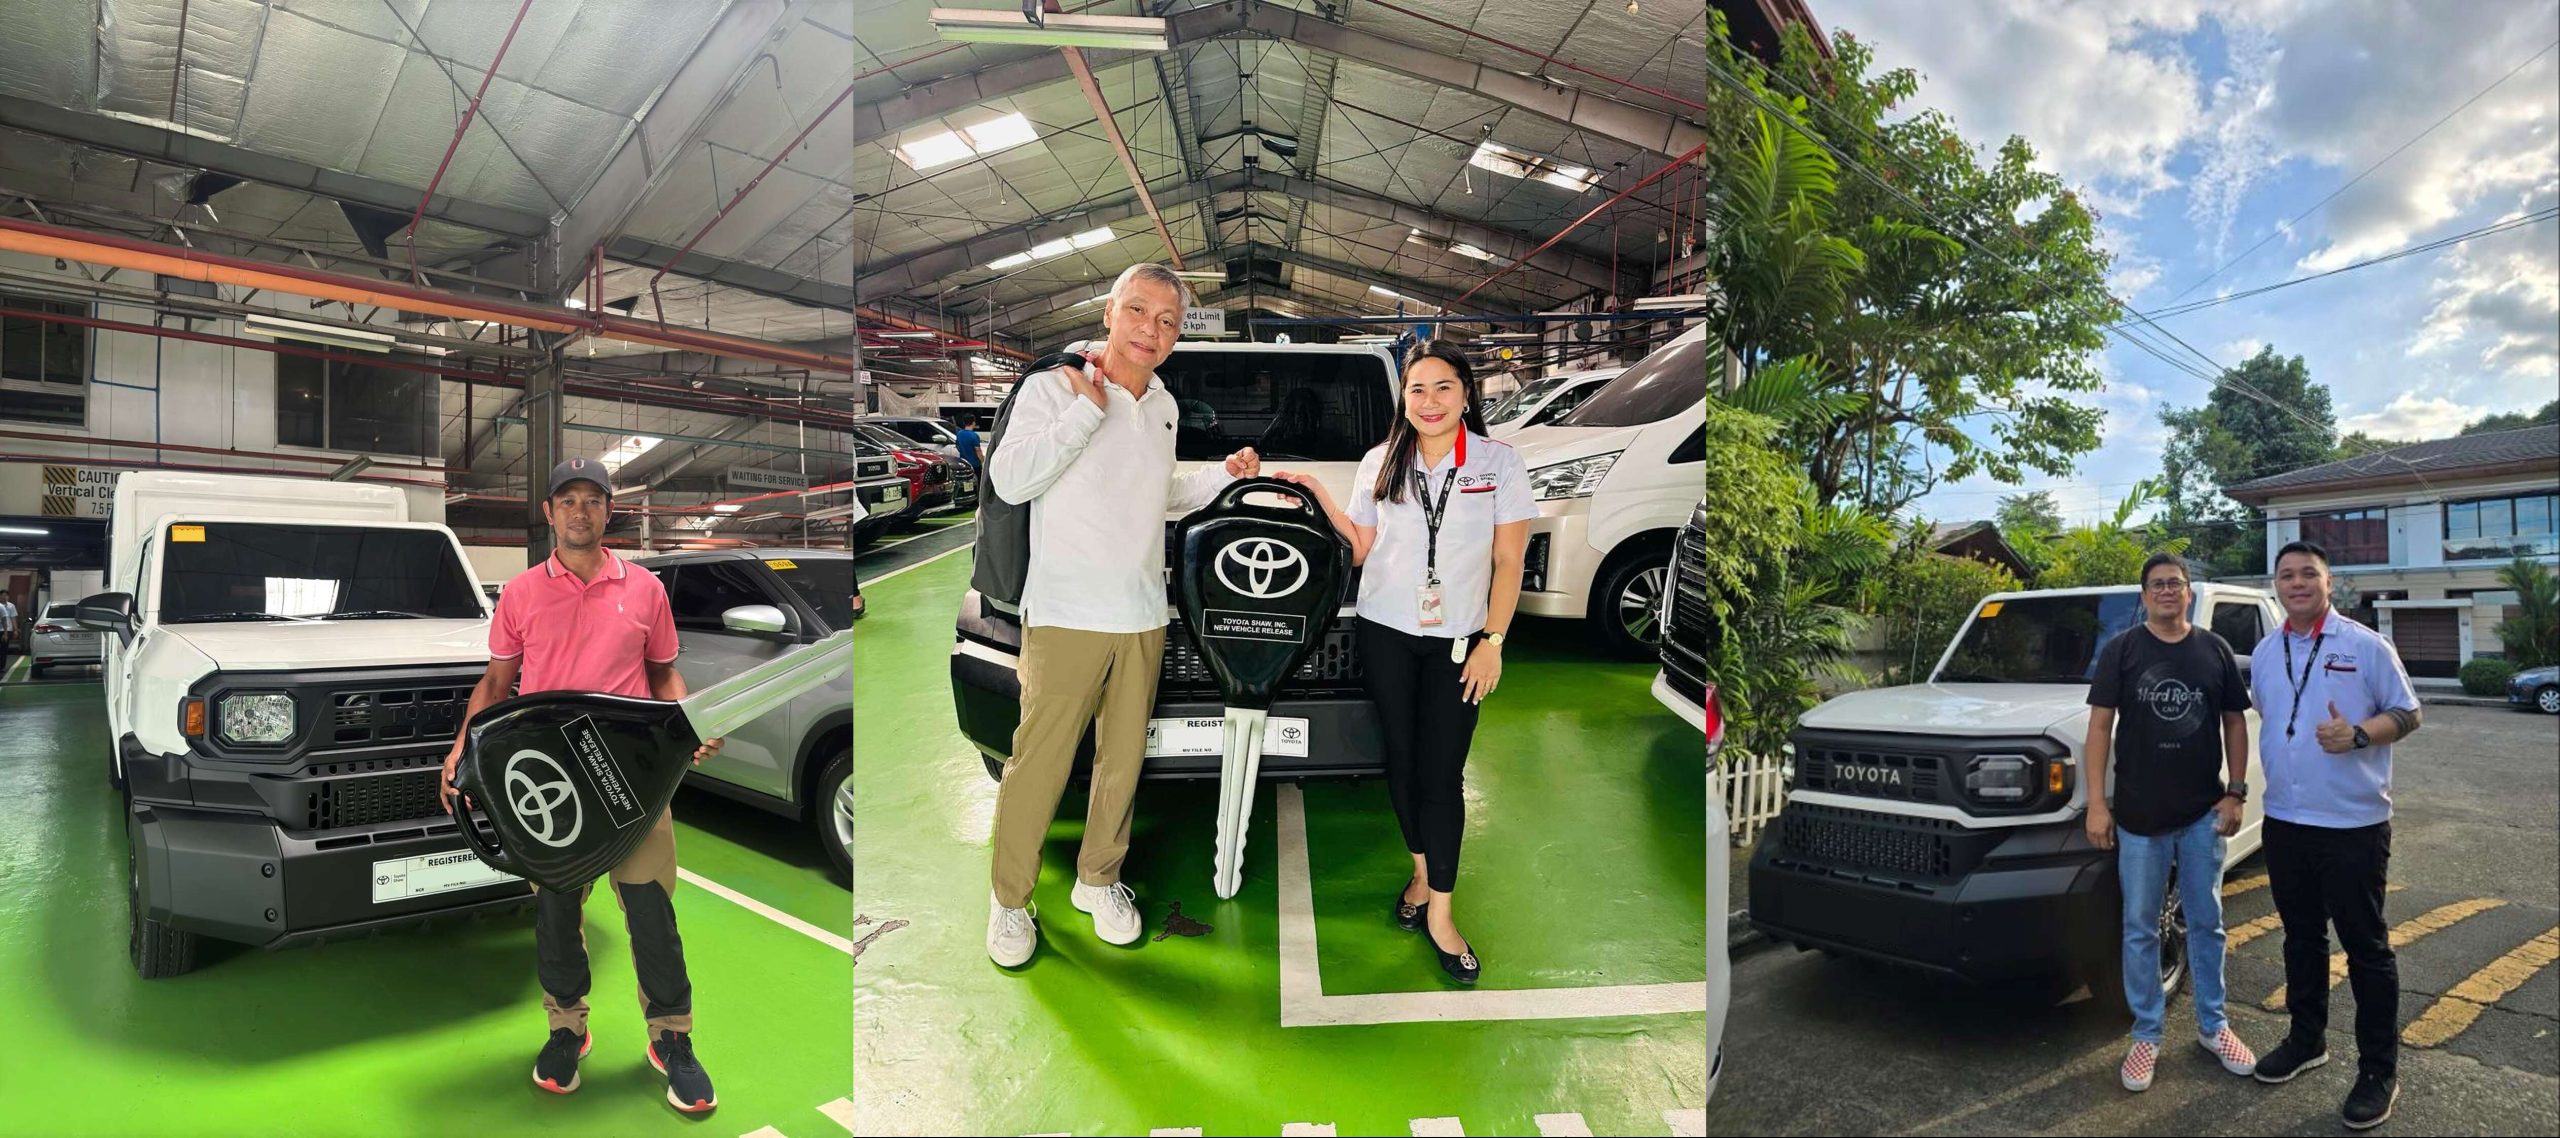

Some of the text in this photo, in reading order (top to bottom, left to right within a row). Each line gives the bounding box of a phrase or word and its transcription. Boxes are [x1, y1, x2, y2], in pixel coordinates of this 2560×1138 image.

[1200, 312, 1220, 320] Limit
[1190, 322, 1206, 331] kph
[78, 470, 120, 484] CAUTIO
[731, 470, 805, 487] WAITING FOR SERVICE
[48, 483, 94, 497] Vertical
[91, 502, 104, 514] 7.5
[1222, 618, 1249, 626] TOYOTA
[1274, 621, 1288, 629] INC.
[1261, 627, 1293, 636] RELEASE
[2138, 687, 2203, 705] Hard Rock
[389, 702, 468, 722] TOYOT
[1187, 720, 1224, 728] REGIST
[579, 738, 590, 754] INC.
[581, 728, 632, 811] NEW VEHICLE RELEASE
[1834, 764, 1901, 785] TOYOTA
[601, 776, 620, 806] TOYOTA
[428, 853, 479, 867] REGISTERED
